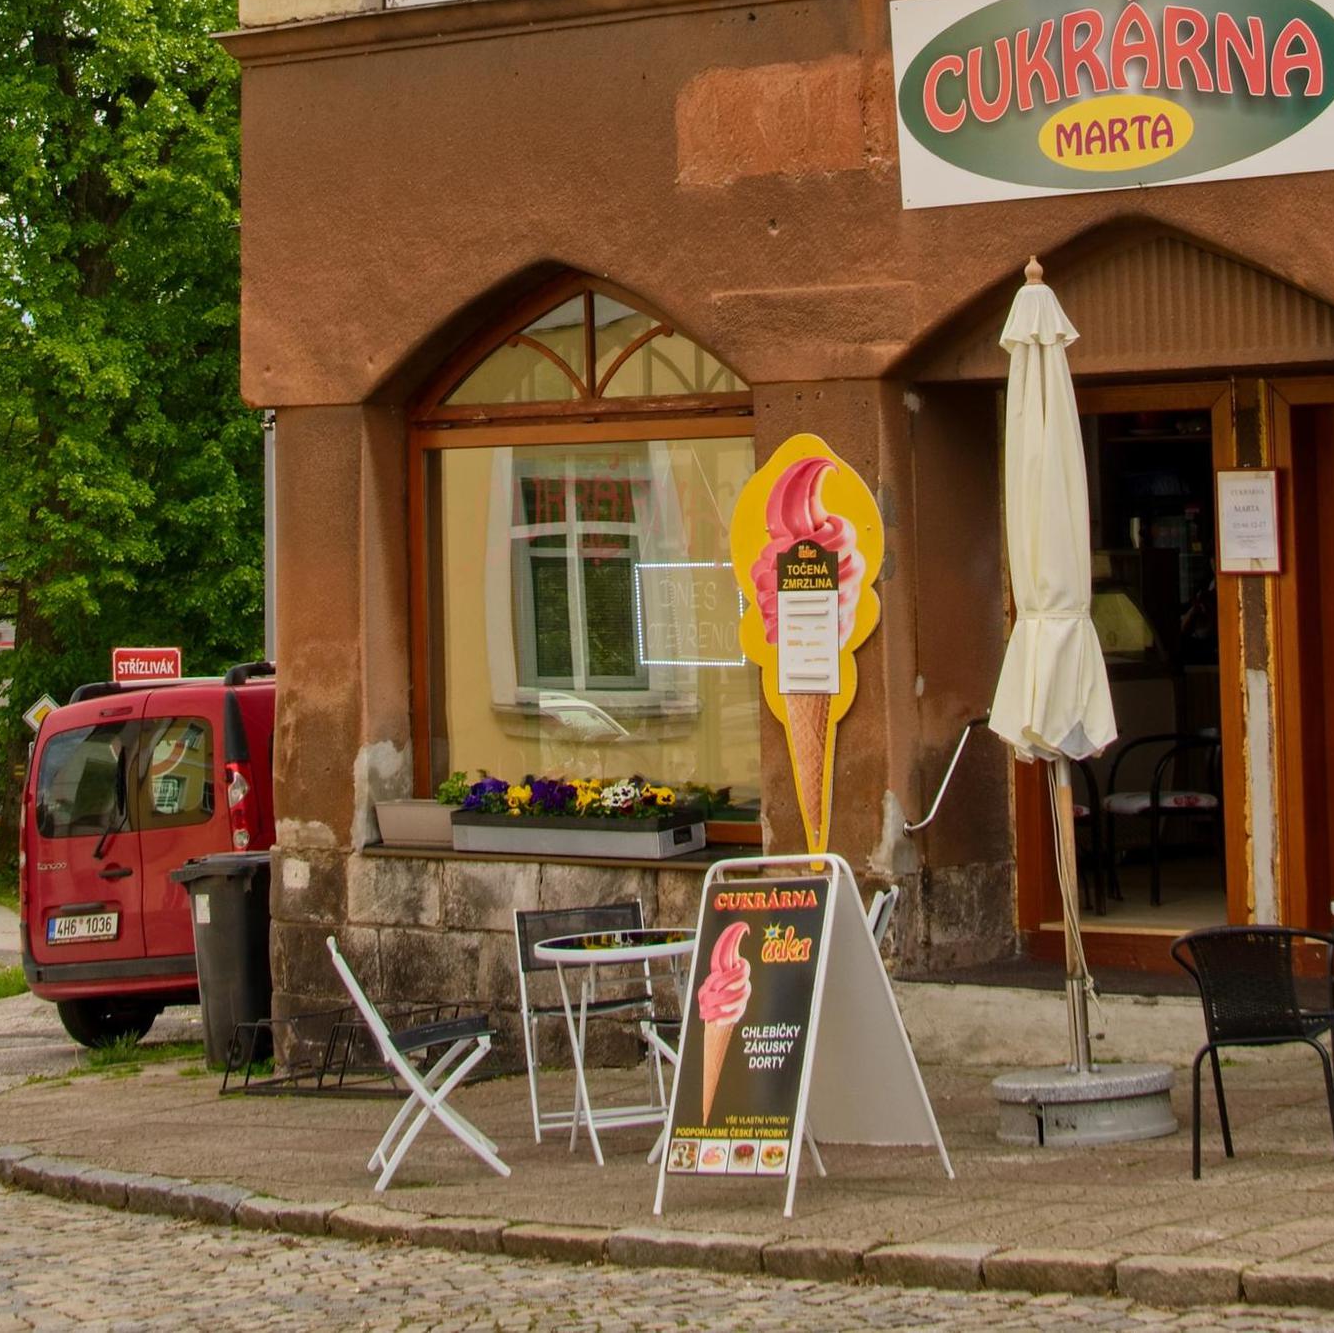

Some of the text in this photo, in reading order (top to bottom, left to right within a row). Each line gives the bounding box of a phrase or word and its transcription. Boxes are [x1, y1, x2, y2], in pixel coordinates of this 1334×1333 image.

[1056, 113, 1174, 158] MARTA
[786, 561, 829, 576] TOČENÁ
[782, 578, 834, 590] ZMRZLINA
[117, 657, 175, 674] STŘÍZLIVÁK
[714, 887, 818, 910] CUKRÁRNA
[57, 916, 112, 937] 4H6 1036
[741, 1022, 801, 1038] CHLEBÍČKY
[743, 1039, 794, 1054] ZÁKUSKY
[748, 1055, 785, 1069] DORTY
[725, 1114, 739, 1125] VŠE
[739, 1114, 765, 1125] VLASTNÍ
[675, 1126, 788, 1137] PODPORUJEME ČESKÉ VÝROBKY
